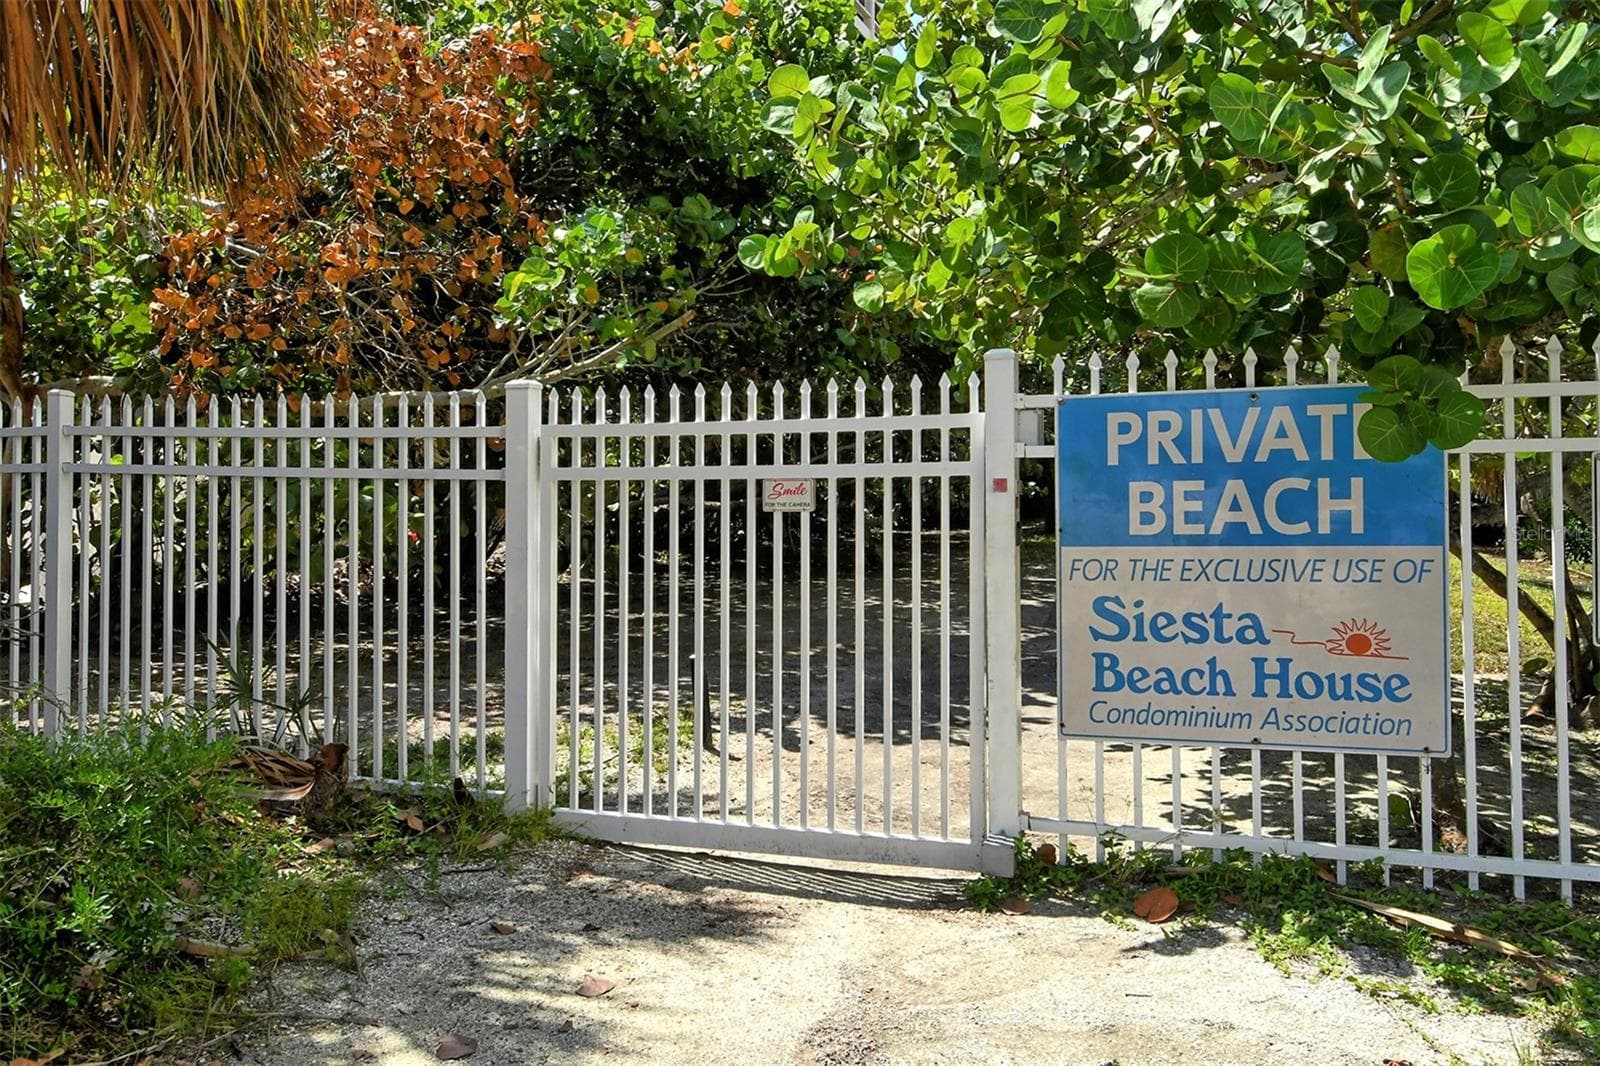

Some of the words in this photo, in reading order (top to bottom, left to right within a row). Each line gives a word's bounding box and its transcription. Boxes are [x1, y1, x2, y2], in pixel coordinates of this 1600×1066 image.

[767, 482, 807, 499] Smile
[1129, 477, 1364, 536] BEACH
[1069, 558, 1119, 582] FOR
[1129, 558, 1174, 582] THE
[1180, 558, 1326, 583] EXCLUSIVE
[1332, 559, 1386, 583] USE
[1393, 559, 1434, 583] OF
[1088, 595, 1271, 646] Siesta
[1091, 652, 1237, 697] Beach
[1250, 656, 1413, 703] House
[1089, 700, 1253, 730] Condominium
[1260, 707, 1412, 737] Association
